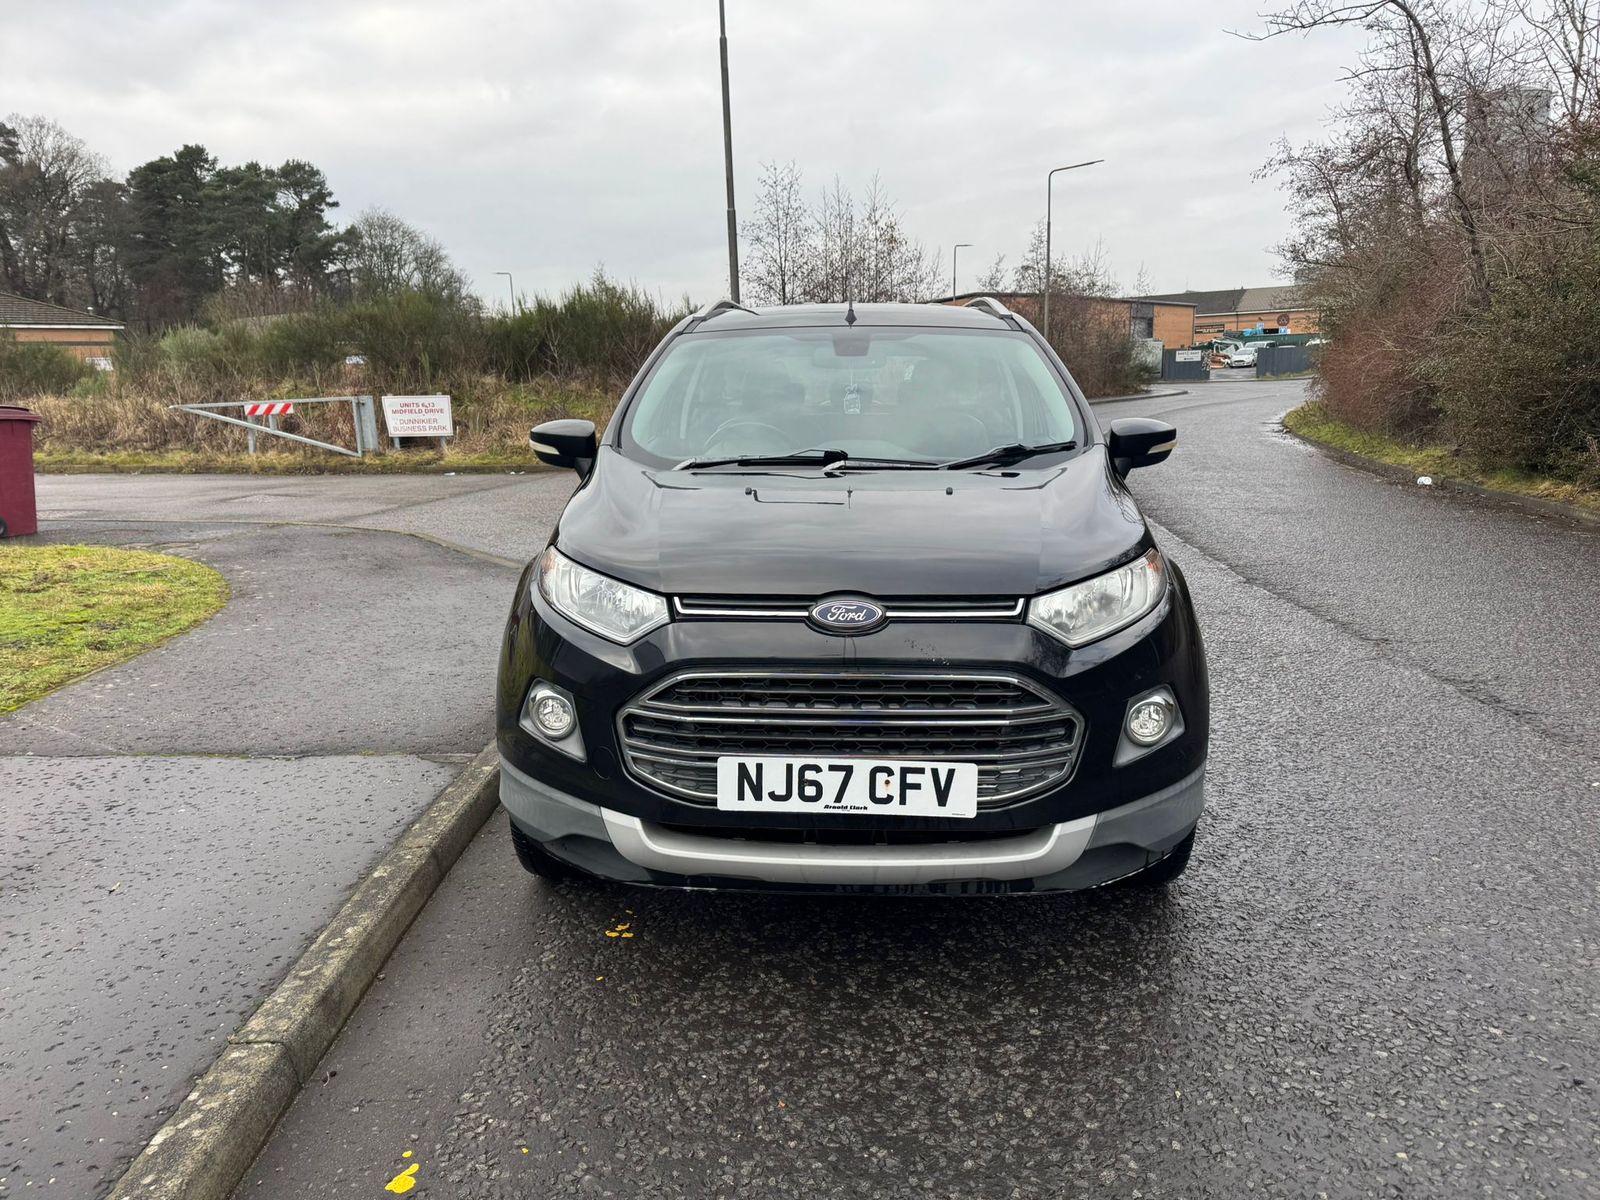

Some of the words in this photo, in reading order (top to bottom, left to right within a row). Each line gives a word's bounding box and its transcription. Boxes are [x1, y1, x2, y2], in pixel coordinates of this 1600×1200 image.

[827, 605, 866, 620] Ford
[737, 762, 854, 804] NJ67
[868, 765, 956, 807] CFV
